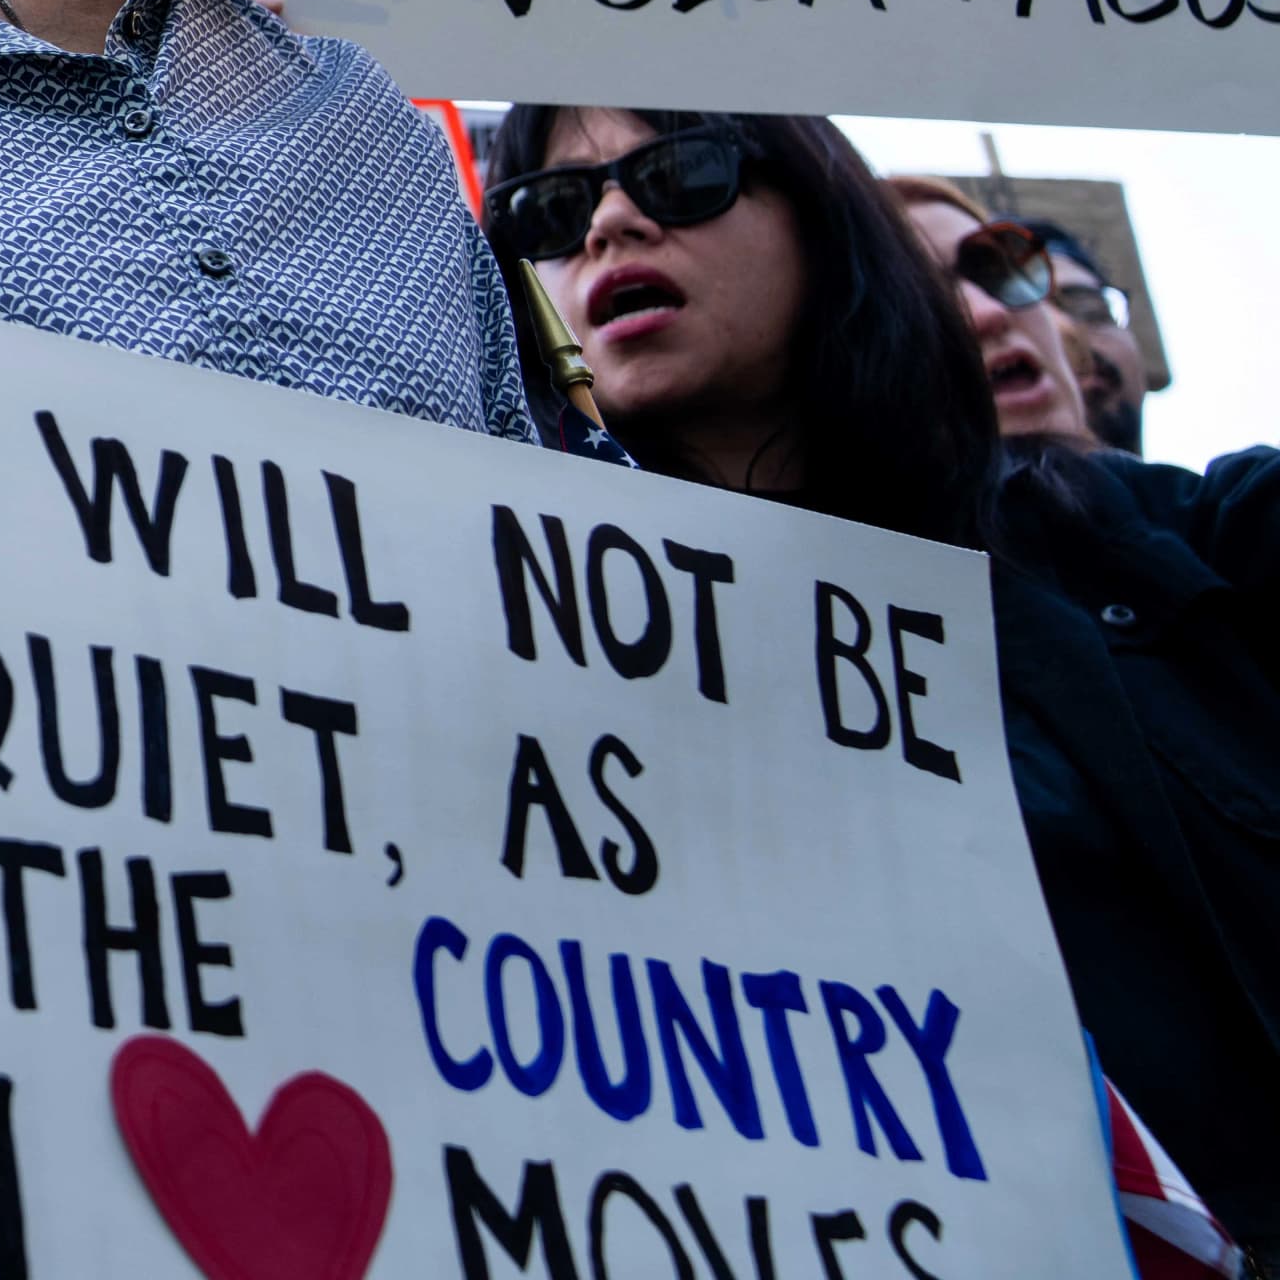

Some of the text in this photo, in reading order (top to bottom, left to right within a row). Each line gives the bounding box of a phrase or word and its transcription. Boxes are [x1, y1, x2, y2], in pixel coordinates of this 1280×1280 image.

[34, 409, 411, 632] WILL
[491, 503, 736, 705] NOT
[814, 579, 962, 784] BE
[501, 733, 660, 897] AS
[413, 917, 989, 1181] COUNTRY
